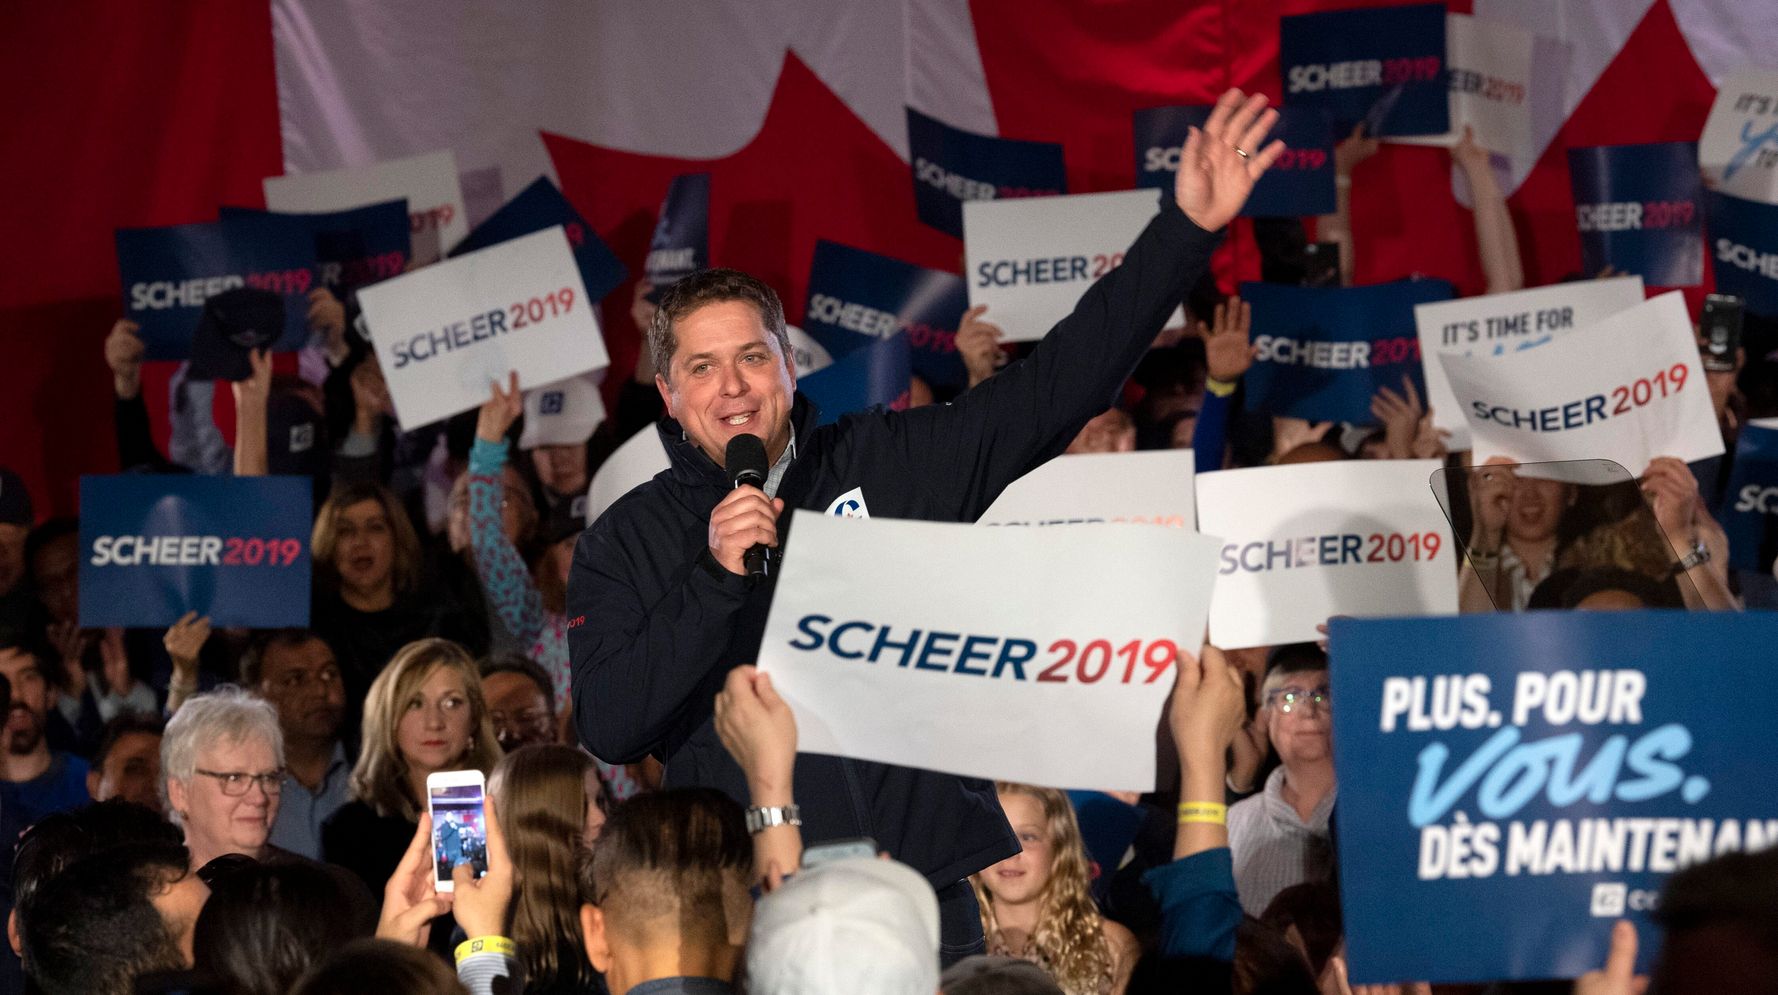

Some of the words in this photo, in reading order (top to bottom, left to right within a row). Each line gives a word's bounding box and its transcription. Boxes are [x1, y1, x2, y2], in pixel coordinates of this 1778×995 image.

[1442, 320, 1479, 346] IT'S
[1486, 312, 1531, 339] TIME
[1535, 306, 1573, 332] FOR
[1380, 675, 1502, 733] PLUS.
[1513, 668, 1648, 727] POUR
[1417, 810, 1501, 881] DÈS
